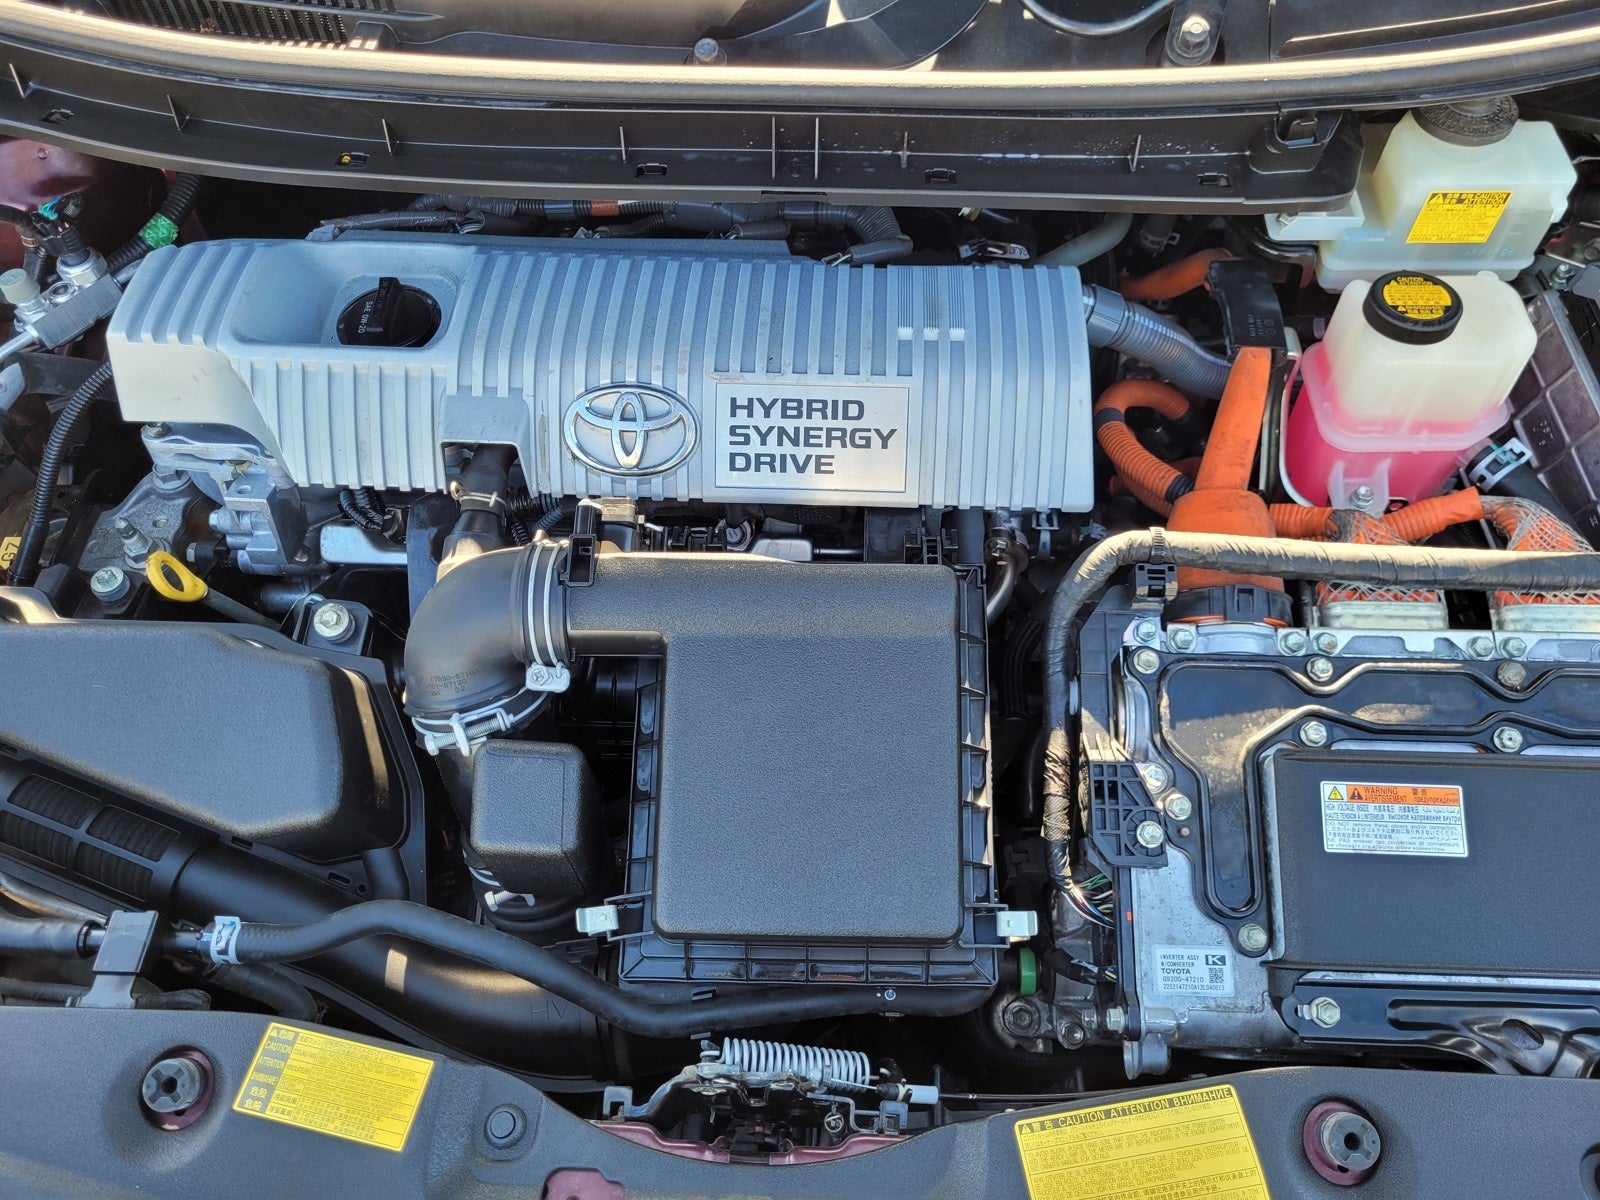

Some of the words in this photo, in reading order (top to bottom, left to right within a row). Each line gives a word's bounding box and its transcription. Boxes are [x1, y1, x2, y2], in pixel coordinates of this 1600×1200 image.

[363, 301, 373, 313] SAE
[729, 397, 865, 421] HYBRID
[729, 425, 898, 450] SYNERGY
[729, 452, 835, 475] DRIVE
[1364, 786, 1397, 794] WARNING
[1365, 794, 1406, 802] AVERTISSEMENT
[264, 1040, 291, 1054] CAUTION
[1058, 1110, 1105, 1127] CAUTION
[1110, 1099, 1170, 1118] ATTENTION
[1174, 1087, 1232, 1107] ВНИМАНИЕ
